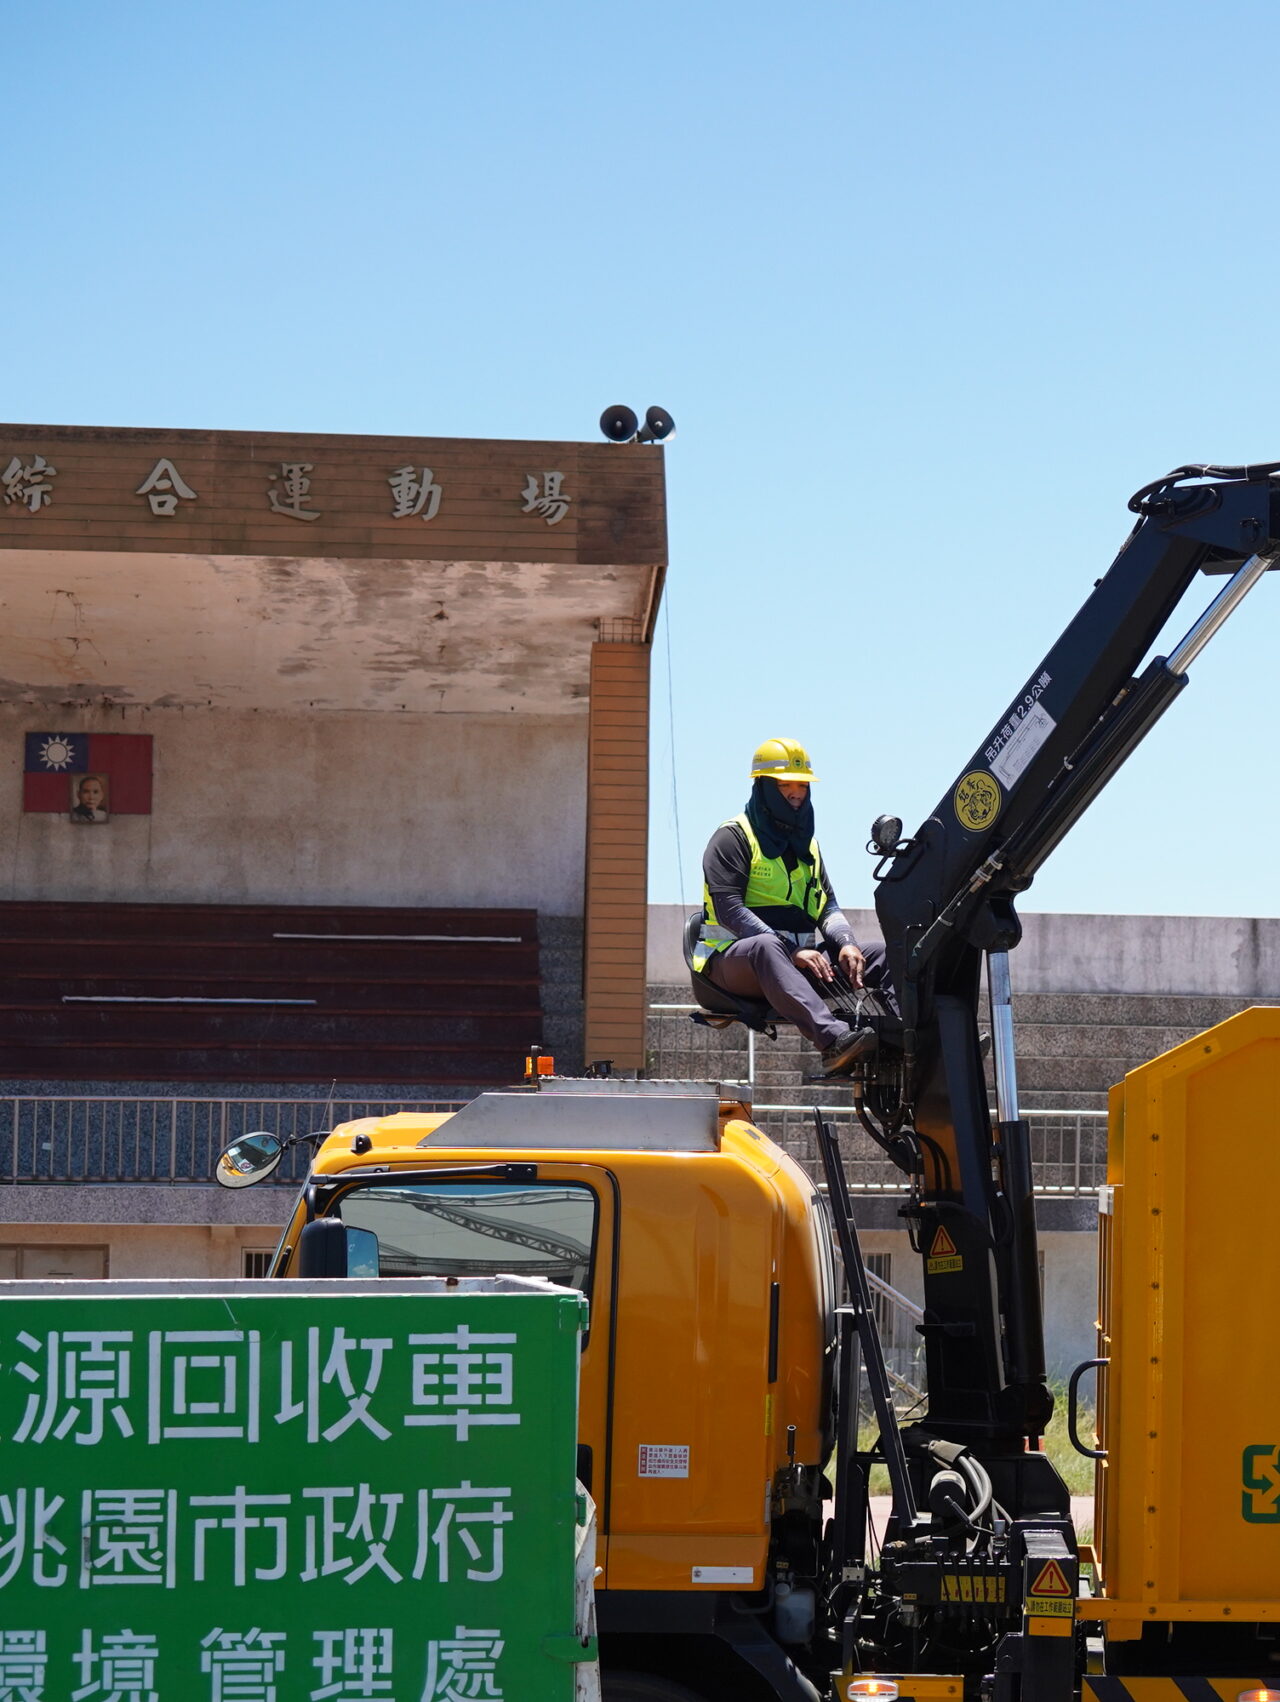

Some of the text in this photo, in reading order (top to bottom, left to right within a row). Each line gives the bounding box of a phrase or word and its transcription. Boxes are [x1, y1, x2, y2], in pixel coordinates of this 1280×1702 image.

[2, 456, 571, 525] 綜合運動場
[0, 1325, 521, 1445] 源回收車
